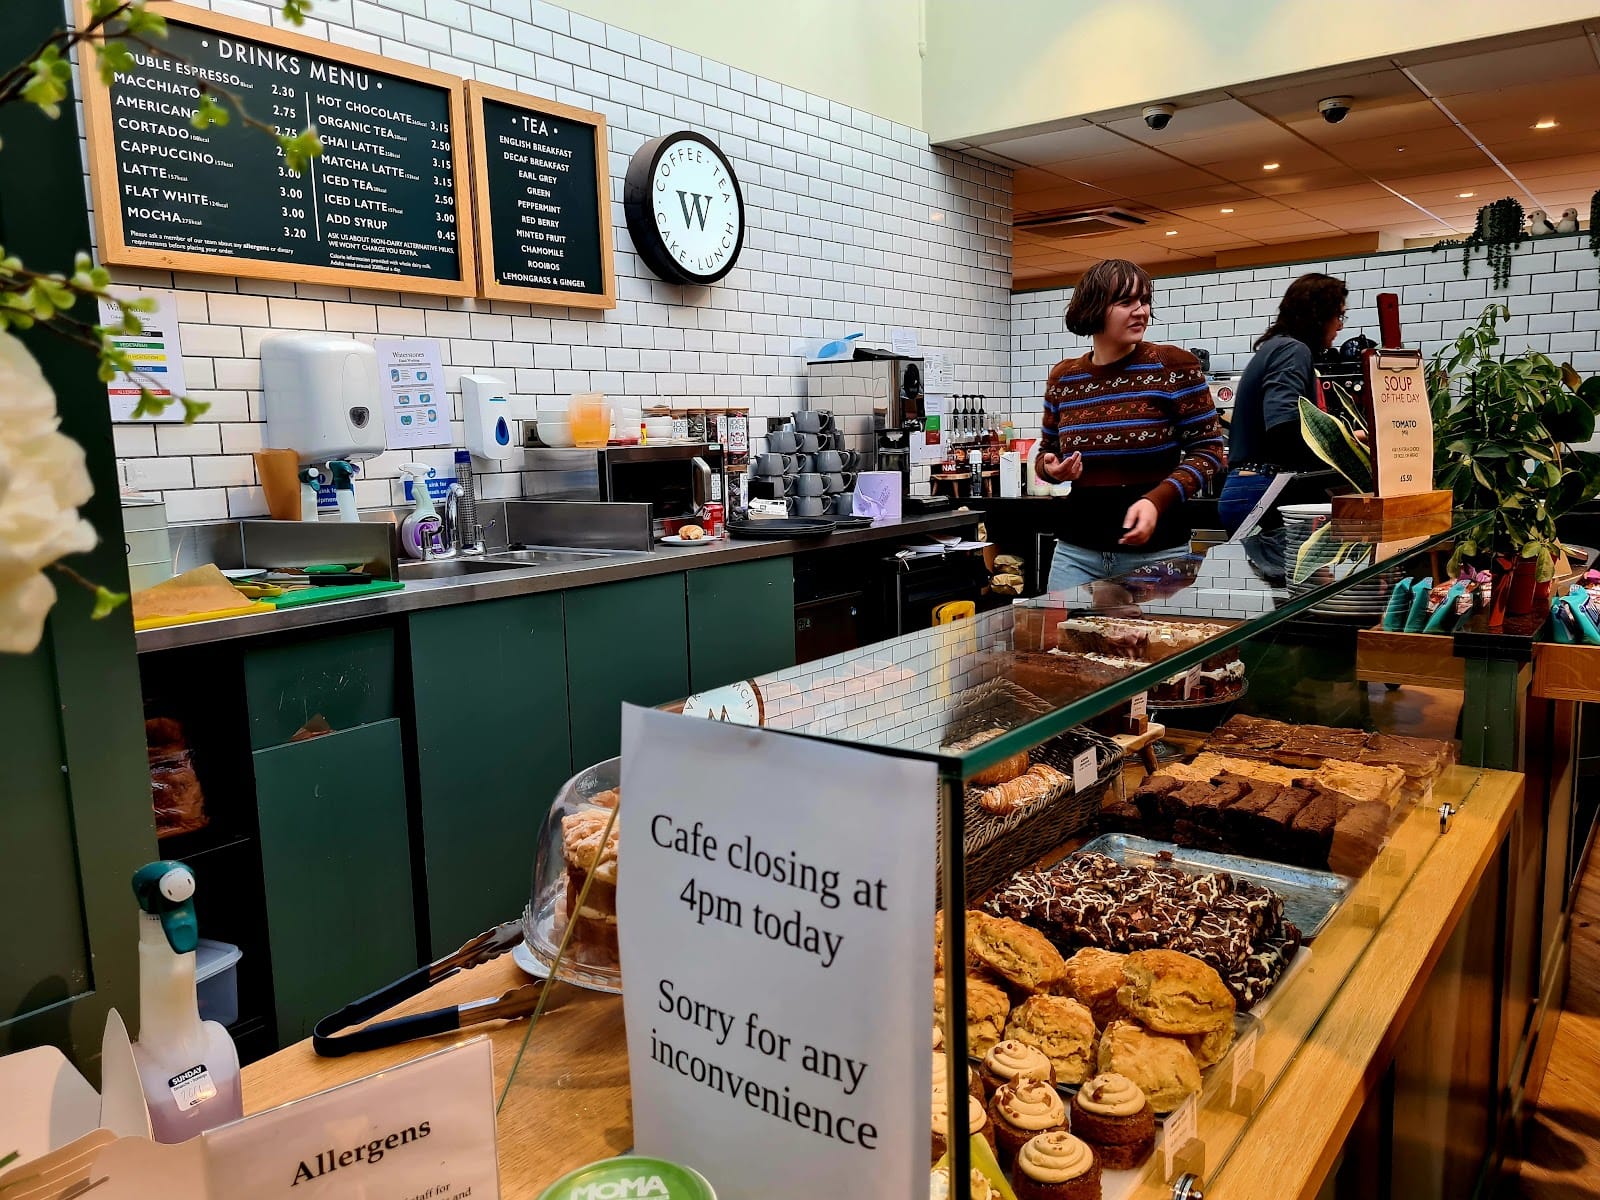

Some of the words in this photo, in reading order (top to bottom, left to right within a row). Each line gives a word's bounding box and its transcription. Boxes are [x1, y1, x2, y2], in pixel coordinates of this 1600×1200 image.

[218, 39, 300, 75] DRINKS
[310, 61, 369, 91] MENU
[176, 62, 240, 86] ESPRESSO
[272, 84, 295, 98] 2.30
[114, 72, 200, 98] MACCHIATO
[272, 105, 296, 118] 2.75
[316, 94, 342, 108] HOT
[346, 101, 412, 124] CHOCOLATE
[430, 121, 449, 132] 3.15
[118, 118, 190, 138] CORTADO
[274, 126, 298, 138] 2.75
[318, 115, 371, 134] ORGANIC
[374, 126, 394, 138] TEA
[432, 140, 450, 151] 2.50
[522, 116, 548, 136] TEA
[120, 140, 214, 164] CAPPUCCINO
[278, 166, 301, 179] 3.00
[320, 134, 348, 148] CHAI
[352, 141, 385, 156] LATTE
[432, 158, 451, 170] 3.15
[500, 136, 531, 150] ENGLISH
[532, 142, 572, 158] BREAKFAST
[321, 154, 368, 172] MATCHA
[372, 164, 404, 178] LATTE
[434, 176, 452, 188] 3.15
[504, 152, 528, 164] DECAF
[530, 156, 570, 172] BREAKFAST
[656, 148, 702, 192] COFFEE
[122, 162, 168, 178] LATTE
[280, 186, 302, 200] 3.00
[518, 170, 537, 181] EARL
[538, 174, 557, 184] GREY
[712, 166, 731, 204] TEA
[125, 185, 159, 198] FLAT
[162, 190, 208, 206] WHITE
[282, 206, 304, 219] 3.00
[322, 174, 350, 187] ICED
[352, 178, 373, 191] TEA
[435, 194, 454, 206] 2.50
[526, 187, 550, 198] GREEN
[324, 194, 350, 206] ICED
[354, 199, 388, 212] LATTE
[436, 212, 454, 223] 3.00
[518, 200, 561, 214] PEPPERMINT
[676, 190, 713, 232] W
[128, 206, 182, 223] MOCHA
[284, 227, 306, 238] 3.20
[326, 214, 350, 224] ADD
[354, 218, 388, 230] SYRUP
[437, 230, 456, 240] 0.45
[522, 216, 536, 224] RED
[538, 218, 560, 228] BERRY
[130, 230, 148, 238] Please
[243, 244, 269, 252] allergens
[277, 247, 294, 255] dietary
[132, 239, 168, 248] requirements
[187, 244, 204, 253] placing
[339, 242, 360, 250] WON'T
[362, 245, 385, 253] CHARGE
[370, 238, 402, 248] NON-DAIRY
[404, 242, 438, 252] ALTERNATIVE
[516, 230, 544, 240] MINTED
[546, 234, 566, 244] FRUIT
[656, 212, 687, 264] CAKE
[698, 222, 734, 270] LUNCH
[521, 244, 564, 257] CHAMOMILE
[528, 260, 560, 271] ROOIBOS
[502, 272, 551, 284] LEMONGRASS
[560, 278, 586, 288] GINGER
[1384, 376, 1412, 392] SOUP
[1381, 394, 1390, 403] OF
[1391, 394, 1404, 402] THE
[1407, 394, 1420, 402] DAY
[1392, 420, 1416, 428] TOMATO
[1400, 474, 1412, 482] £5.50
[650, 814, 718, 861] Cafe
[728, 835, 840, 908] closing
[854, 878, 888, 910] at
[680, 878, 742, 927] 4pm
[753, 902, 844, 968] today
[658, 979, 736, 1045] Sorry
[746, 1013, 792, 1062] for
[802, 1043, 868, 1095] any
[172, 1066, 202, 1085] SUNDAY
[650, 1028, 878, 1151] inconvenience
[290, 1120, 431, 1187] Allergens
[436, 1184, 450, 1195] for
[453, 1186, 472, 1200] and
[571, 1176, 669, 1200] MOMA
